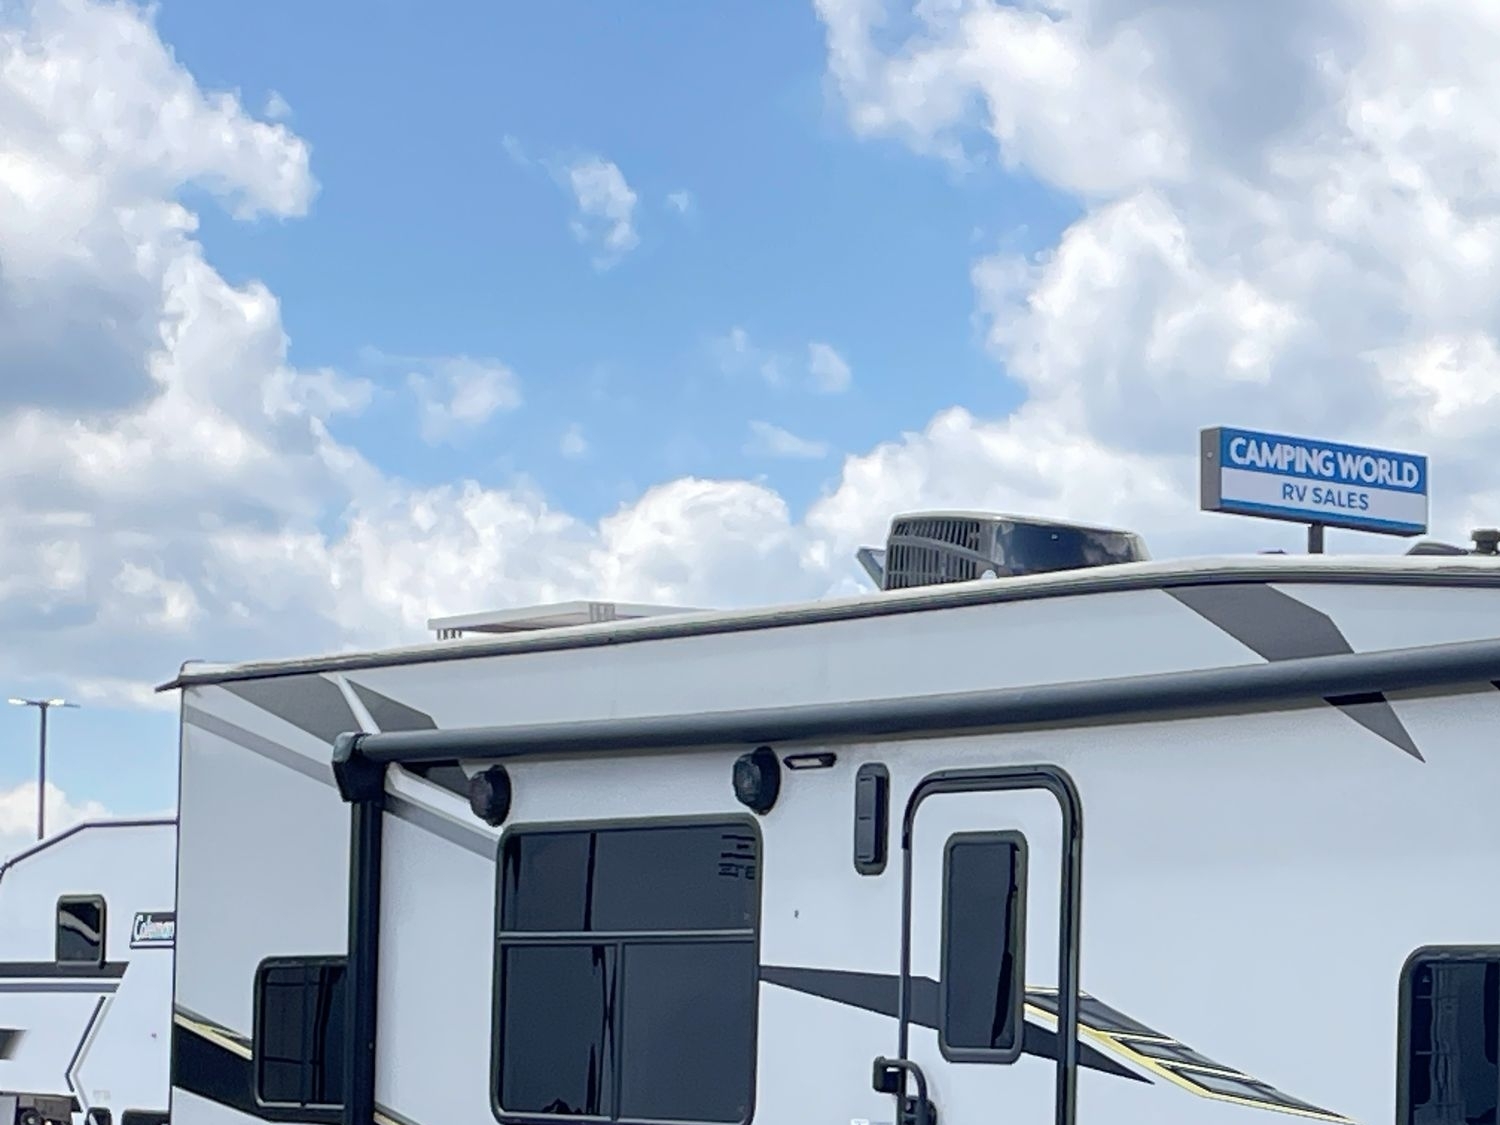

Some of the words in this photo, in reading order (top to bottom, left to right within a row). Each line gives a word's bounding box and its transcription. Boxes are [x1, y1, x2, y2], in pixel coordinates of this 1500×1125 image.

[1229, 436, 1336, 477] CAMPING
[1338, 452, 1420, 489] WORLD
[1282, 483, 1308, 502] RV
[1312, 487, 1370, 510] SALES
